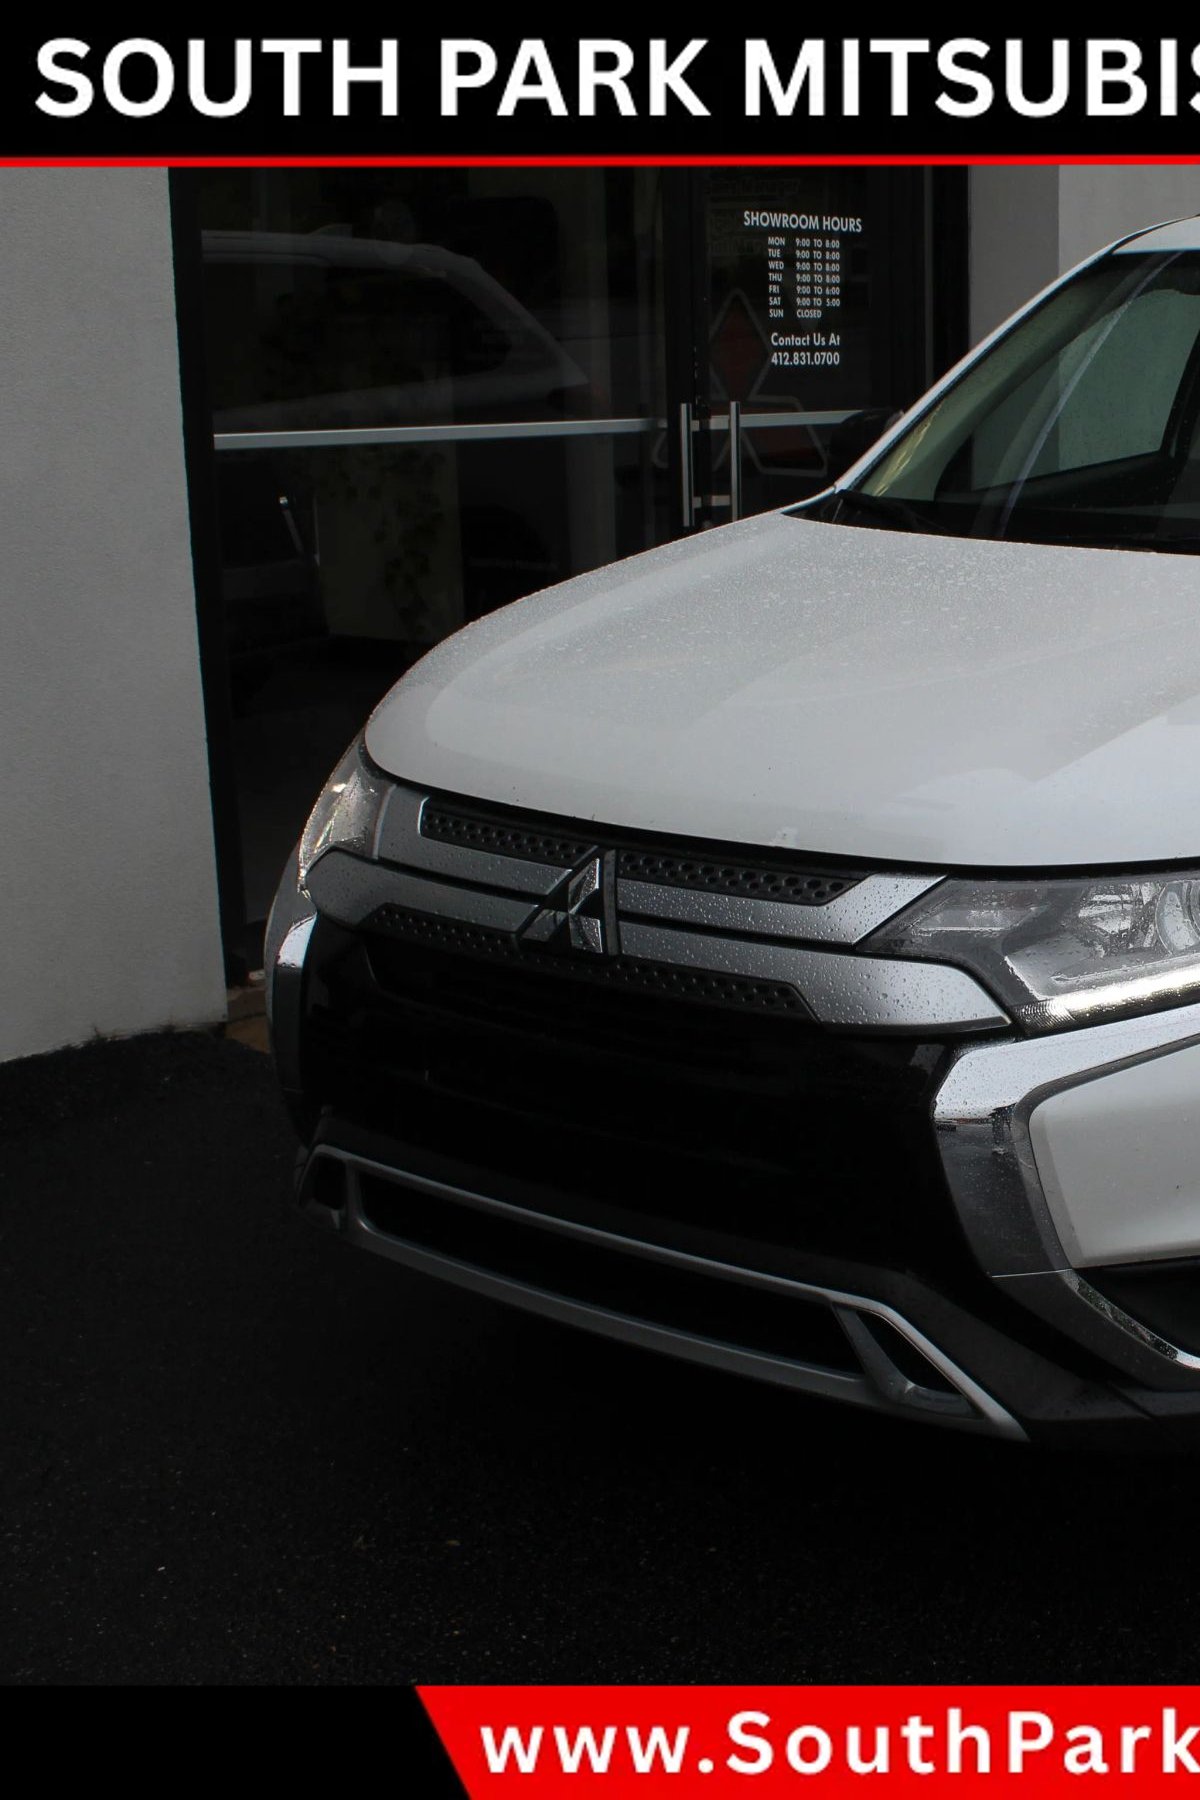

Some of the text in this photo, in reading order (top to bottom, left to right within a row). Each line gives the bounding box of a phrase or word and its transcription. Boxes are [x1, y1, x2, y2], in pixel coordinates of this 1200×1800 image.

[743, 210, 820, 231] SHOWROOM
[822, 216, 863, 233] HOURS
[768, 236, 786, 246] MON
[795, 237, 811, 247] 9:00
[813, 238, 823, 248] TO
[768, 248, 781, 258] TUE
[795, 249, 811, 259] 9:00
[813, 250, 823, 260] TO
[768, 260, 785, 270] WED
[795, 261, 811, 271] 9:00
[813, 262, 823, 272] TO
[768, 272, 783, 282] THU
[795, 273, 811, 283] 9:00
[813, 274, 823, 283] TO
[768, 284, 780, 294] FRI
[795, 285, 811, 294] 9:00
[813, 286, 823, 295] TO
[769, 296, 781, 306] SAT
[795, 297, 811, 306] 9:00
[813, 297, 823, 306] TO
[769, 308, 822, 319] SUN CLOSED
[770, 332, 841, 346] Contact Us At
[770, 351, 841, 366] 412.831.0700
